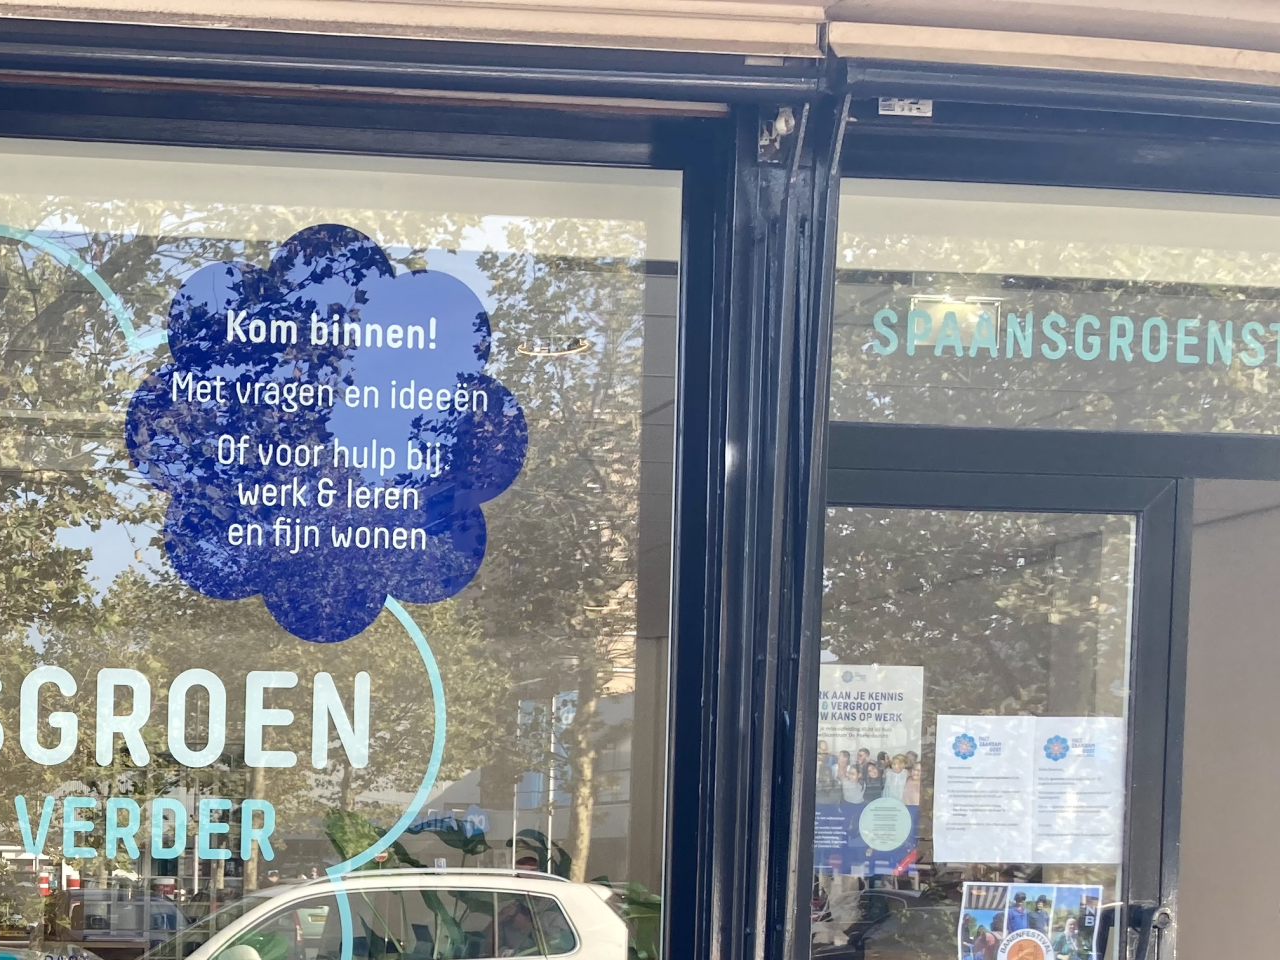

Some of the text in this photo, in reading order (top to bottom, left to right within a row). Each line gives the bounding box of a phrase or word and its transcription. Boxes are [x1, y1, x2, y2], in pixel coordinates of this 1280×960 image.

[226, 309, 437, 350] Kom binnen!
[171, 372, 489, 412] Met vragen en ideeën
[217, 434, 442, 477] Of voor hulp bij
[237, 477, 419, 510] werk & leren
[228, 518, 428, 554] en fijn wonen
[831, 691, 851, 700] AAN
[853, 692, 866, 700] JE
[868, 692, 904, 702] KENNIS
[831, 702, 882, 711] VERGROOT
[831, 712, 857, 721] KANS
[859, 713, 872, 721] OP
[875, 713, 903, 722] WERK
[16, 795, 277, 861] VERDER
[999, 930, 1053, 955] BANENFESTIVAL
